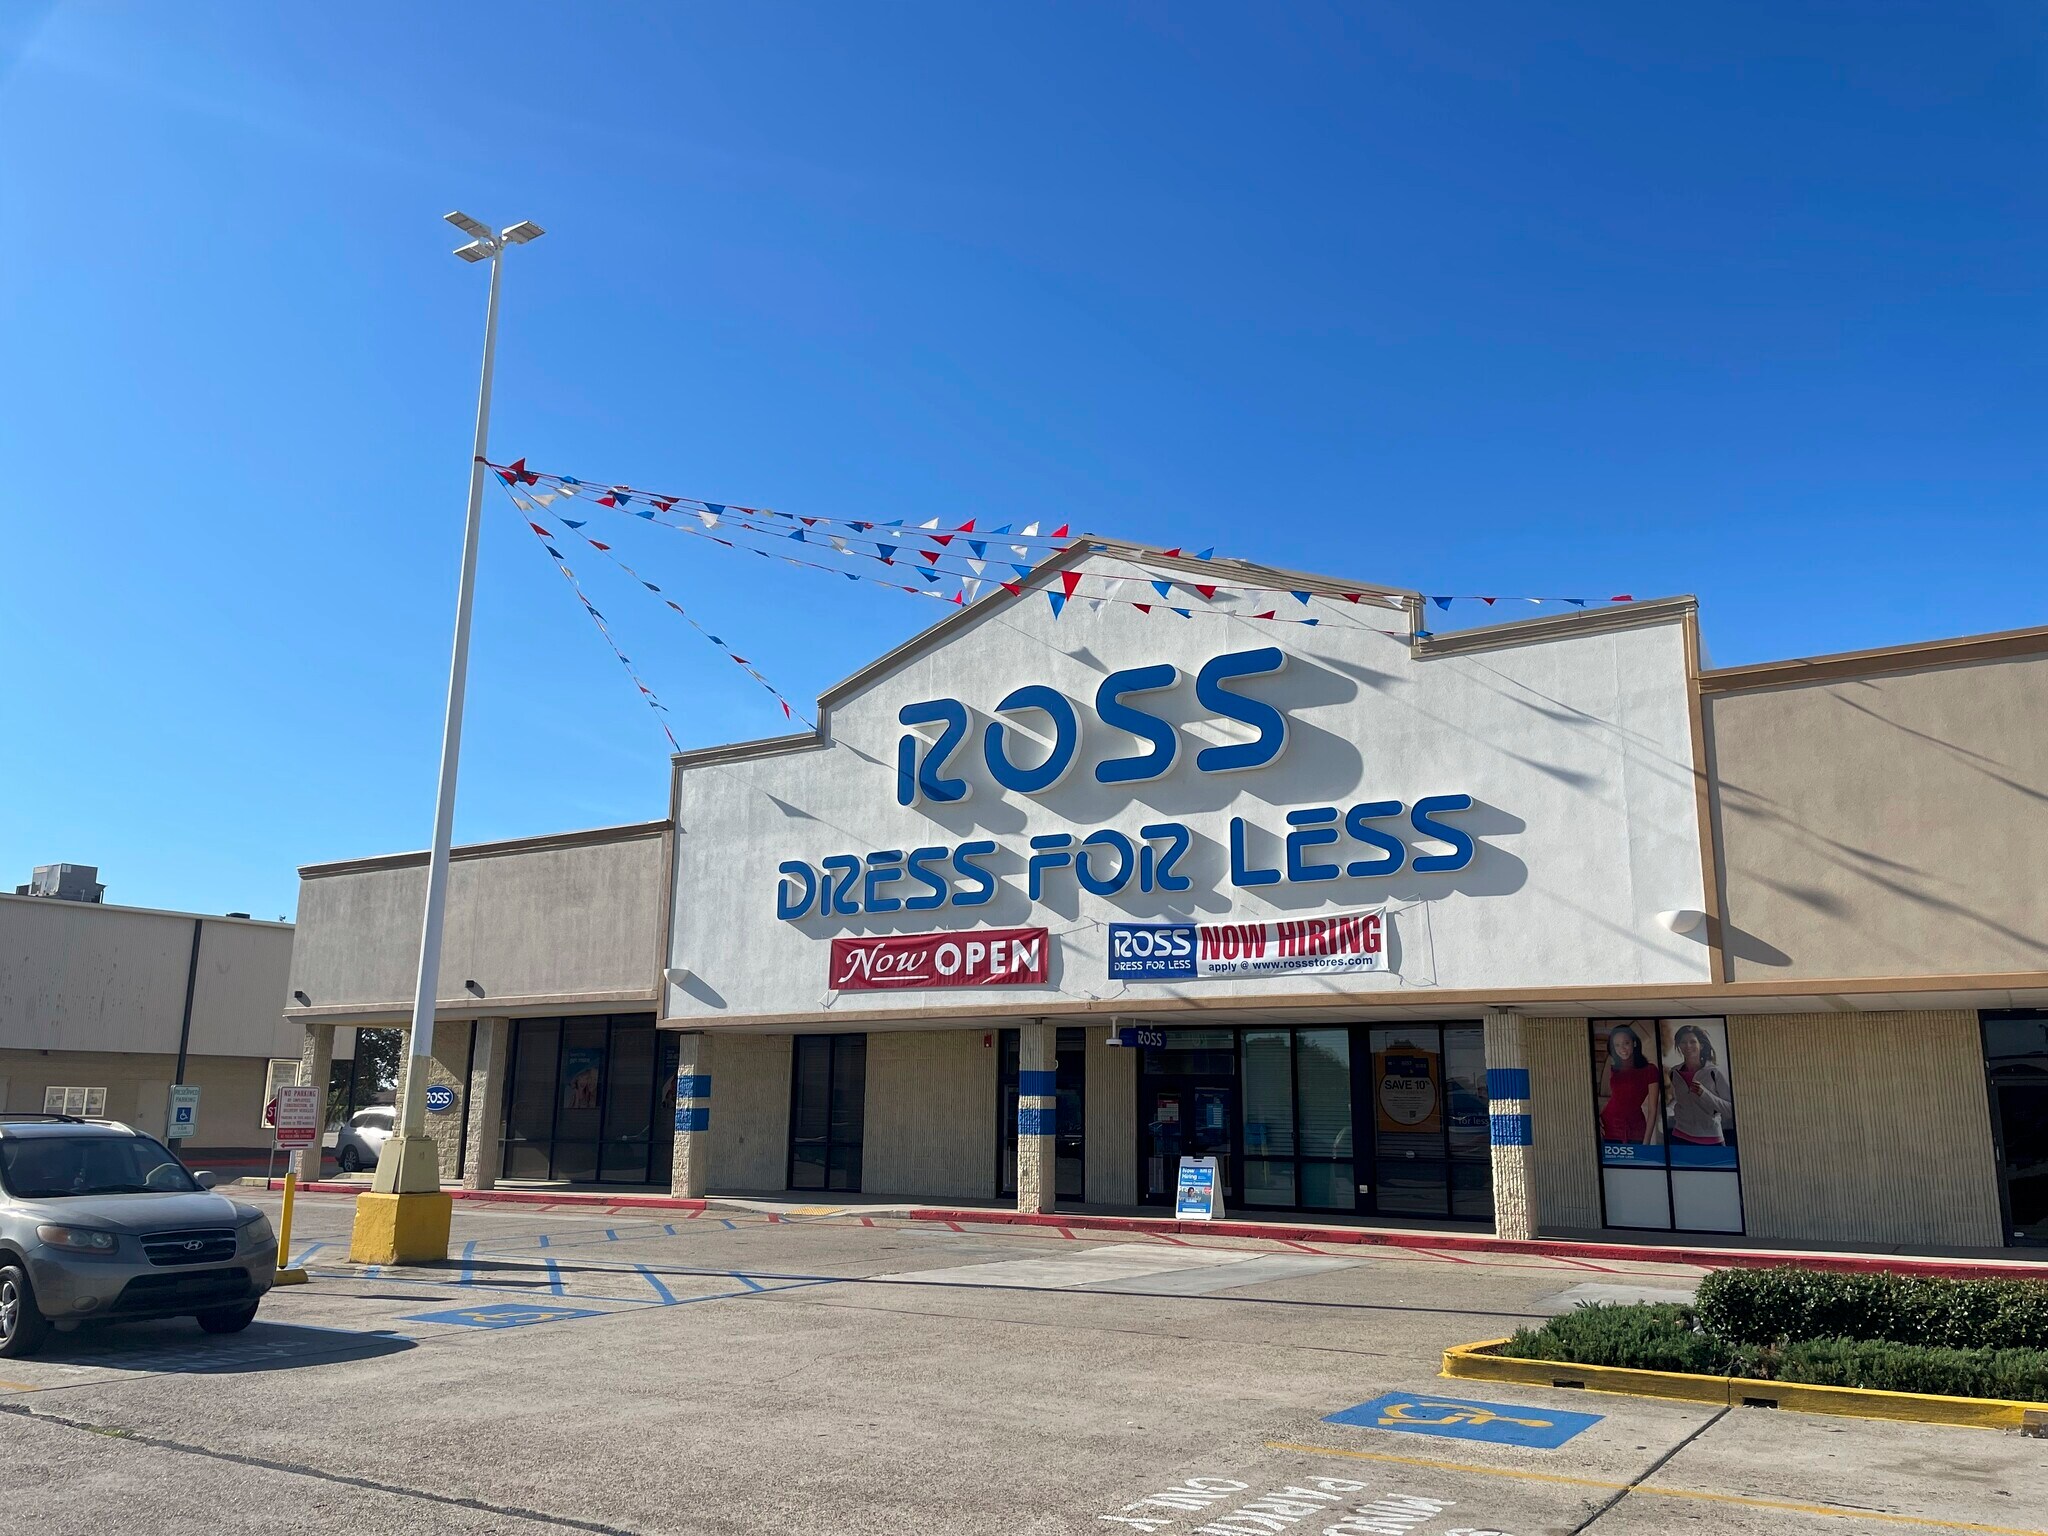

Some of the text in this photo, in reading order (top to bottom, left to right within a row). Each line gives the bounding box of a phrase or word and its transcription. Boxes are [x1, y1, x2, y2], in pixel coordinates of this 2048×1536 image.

[896, 647, 1288, 807] ROSS
[777, 794, 1474, 921] DRESS FOR LESS
[1114, 929, 1191, 958] ROSS
[1200, 915, 1382, 960] NOW HIRING
[934, 938, 1040, 976] OPEN
[1114, 960, 1191, 971] DRESS FOR LESS
[1208, 956, 1373, 973] apply @ www.rossstores.com
[1137, 1031, 1162, 1047] ROSS
[1384, 1080, 1413, 1090] SAVE
[1604, 1146, 1634, 1156] ROSS
[1097, 1477, 1250, 1533] ONLY
